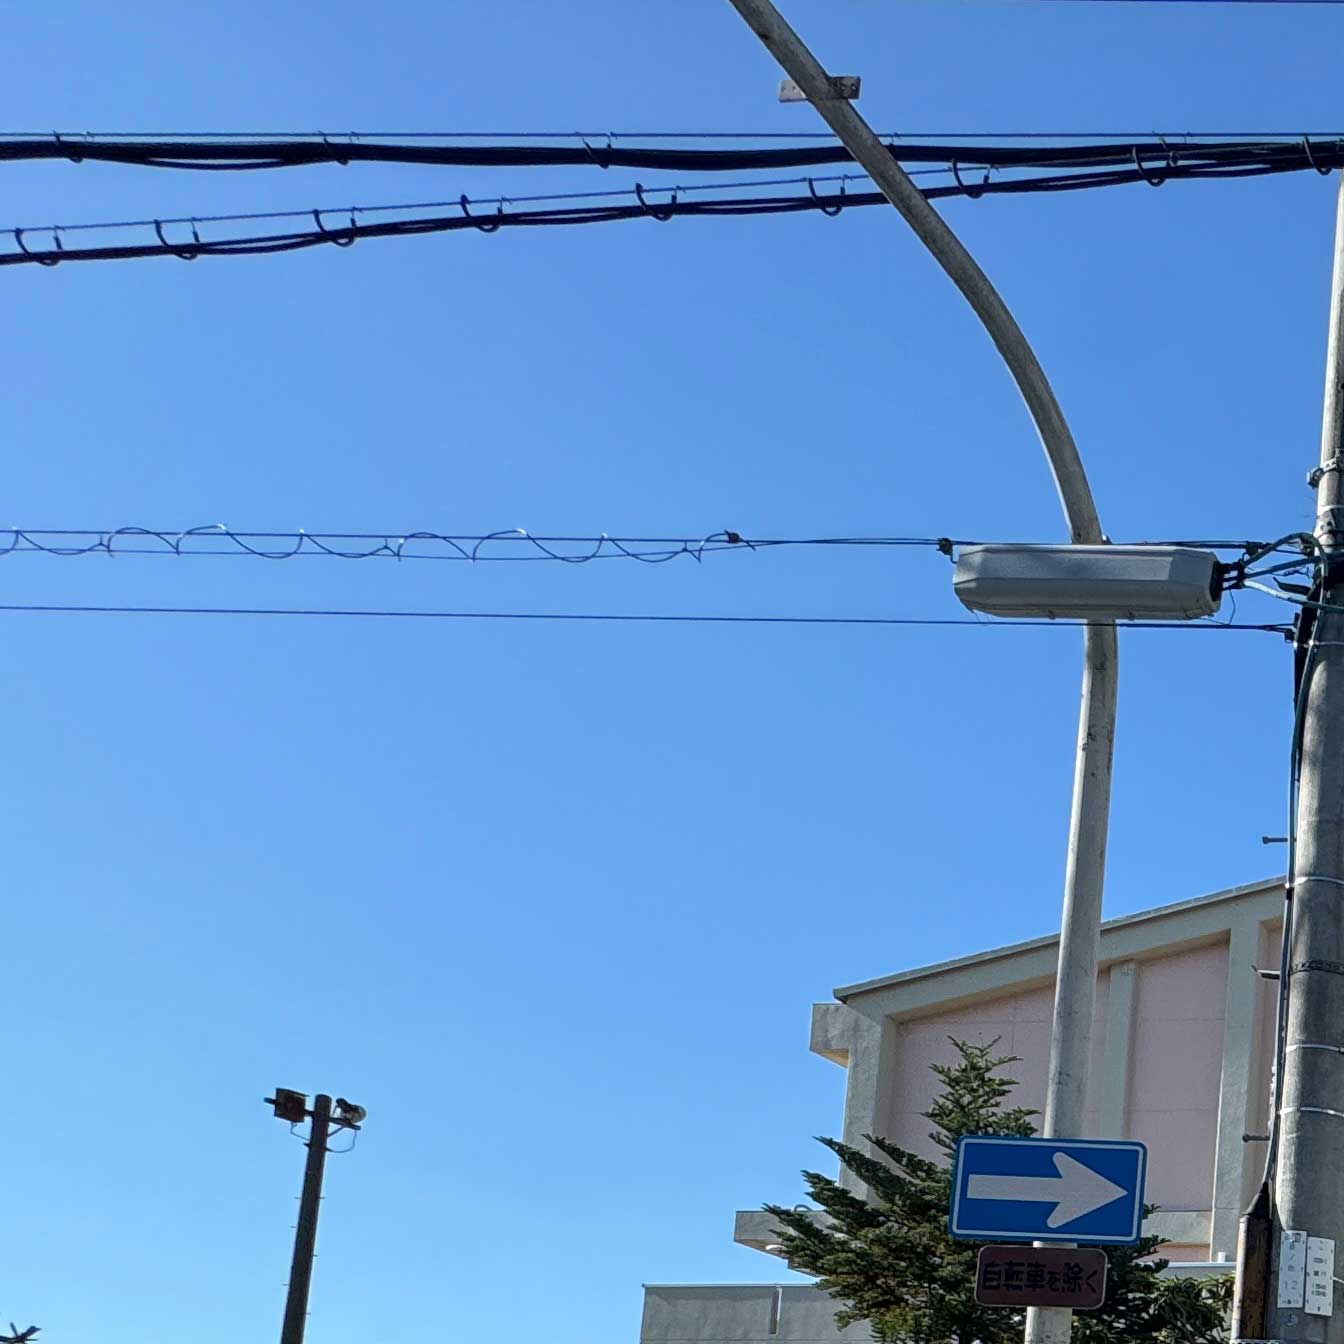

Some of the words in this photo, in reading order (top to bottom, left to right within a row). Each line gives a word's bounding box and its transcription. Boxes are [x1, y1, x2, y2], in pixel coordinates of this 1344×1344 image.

[982, 1261, 1098, 1294] 自転車を除く
